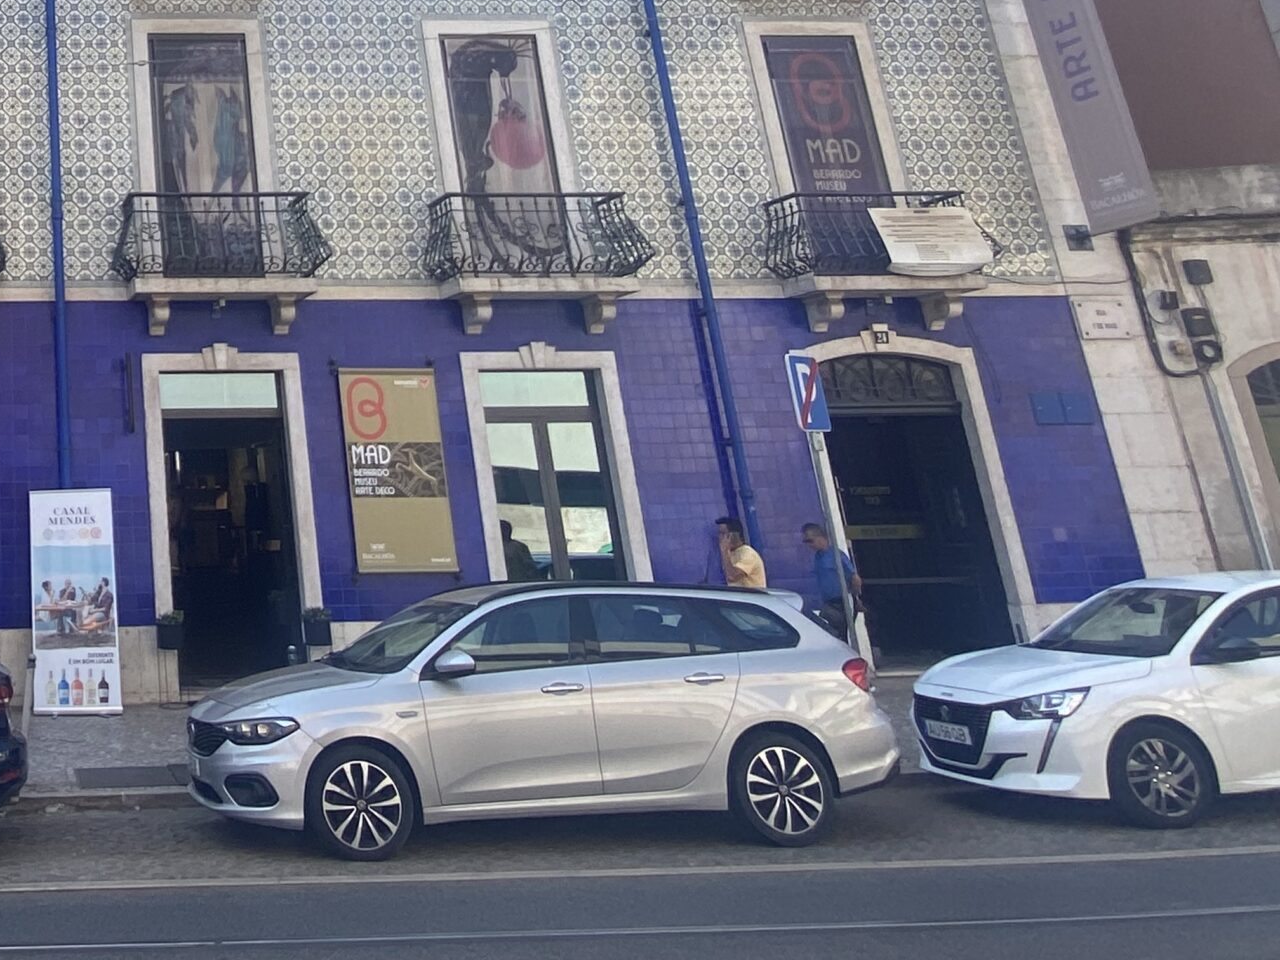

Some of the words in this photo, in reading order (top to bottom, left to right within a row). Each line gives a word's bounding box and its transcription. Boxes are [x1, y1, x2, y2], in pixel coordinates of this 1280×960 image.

[1049, 11, 1100, 102] ARTE
[805, 138, 862, 164] MAD
[812, 168, 862, 180] BERARDO
[815, 180, 847, 191] MUSEU
[351, 444, 391, 465] MAD
[353, 468, 390, 477] BERARDO
[354, 477, 378, 486] MUSEU
[355, 486, 374, 495] ARTE
[375, 486, 396, 495] DECO
[52, 506, 91, 516] CASAL
[48, 515, 97, 526] MENDES
